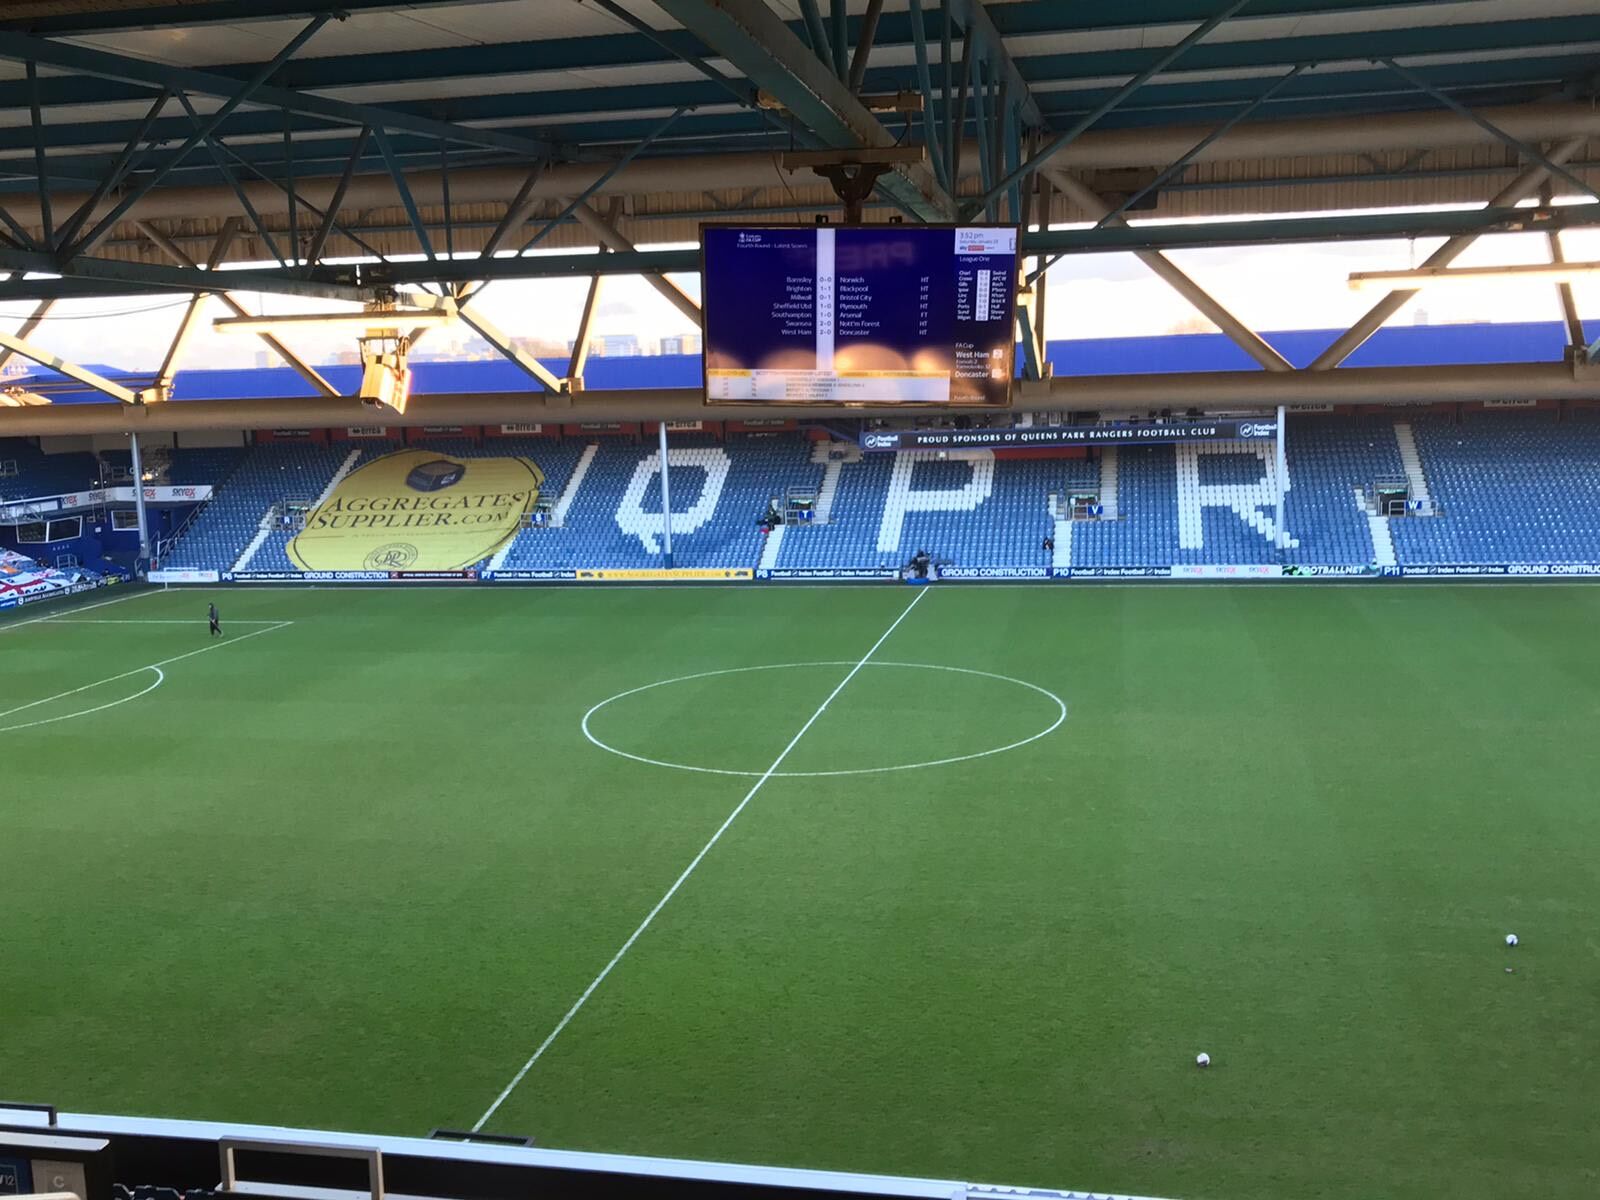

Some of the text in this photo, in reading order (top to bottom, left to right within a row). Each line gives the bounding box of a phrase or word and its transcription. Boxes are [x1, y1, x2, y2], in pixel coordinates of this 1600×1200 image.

[1021, 433, 1057, 442] QUEENS
[322, 492, 525, 512] AGGREGATES
[1408, 500, 1418, 510] W
[802, 510, 809, 518] T
[1092, 505, 1099, 514] V
[311, 510, 509, 529] SUPPLIER.COM
[536, 513, 542, 522] S
[756, 570, 768, 578] P8
[942, 568, 1047, 577] GROUND CONSTRUCTION
[1053, 568, 1069, 576] P10
[1384, 566, 1400, 575] P11
[1508, 565, 1549, 574] GROUND
[222, 572, 232, 580] P6
[482, 571, 491, 579] P7
[53, 1176, 64, 1188] C
